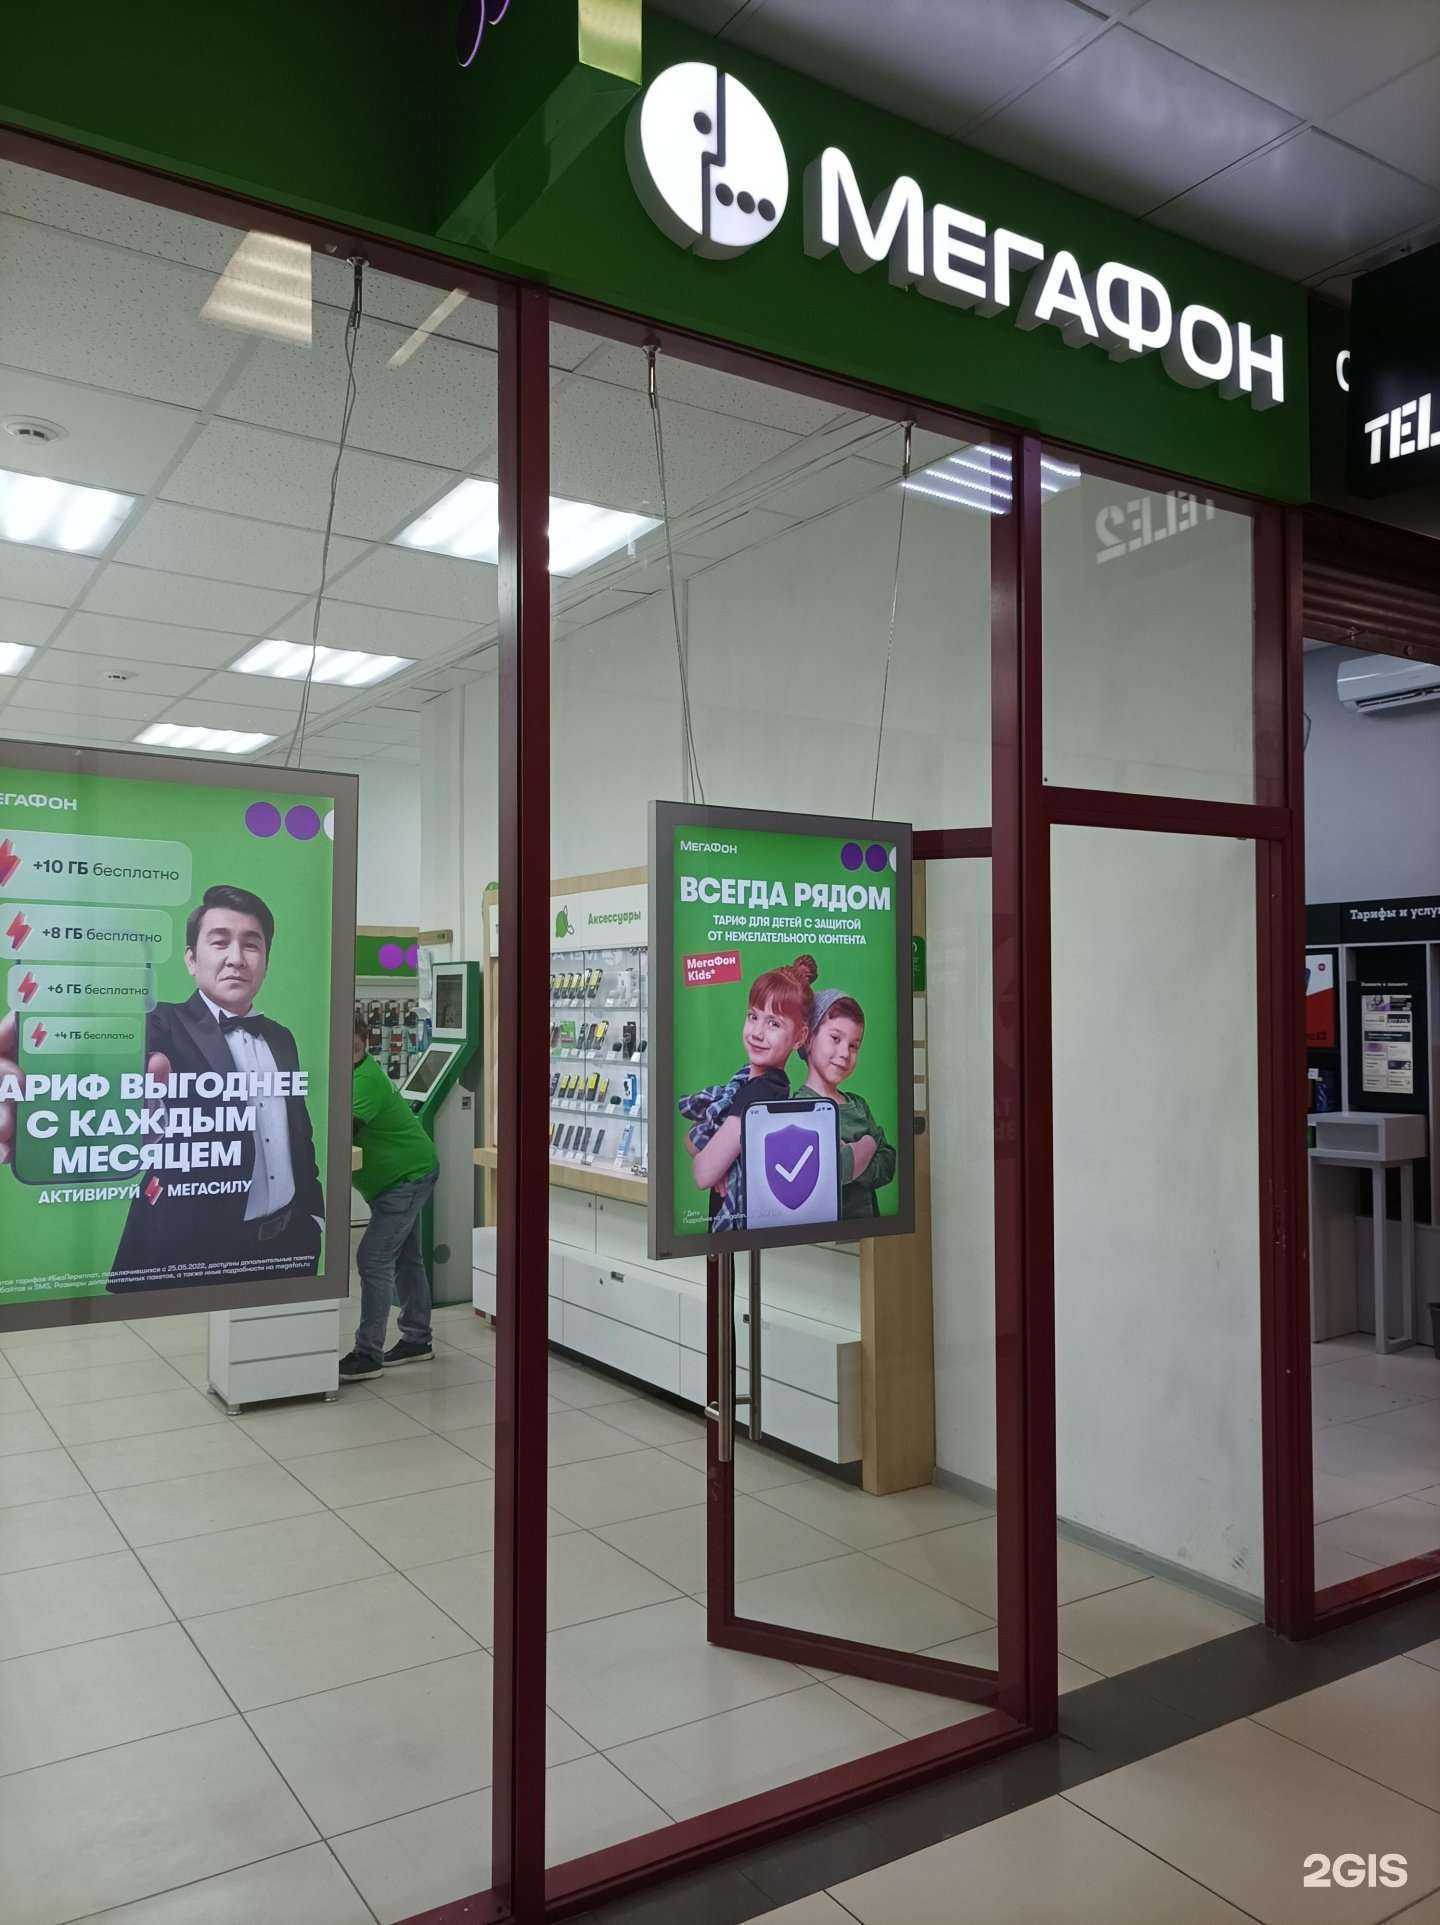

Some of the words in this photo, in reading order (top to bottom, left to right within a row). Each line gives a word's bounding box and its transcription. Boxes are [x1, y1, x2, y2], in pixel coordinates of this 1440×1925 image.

[33, 859, 64, 874] +10
[68, 861, 88, 875] ГБ
[93, 863, 179, 881] бесплатно
[680, 876, 789, 909] ВСЕГДА
[794, 882, 891, 912] РЯДОМ
[588, 911, 641, 925] Аксессуары
[713, 914, 747, 926] ТАРИФ
[749, 916, 769, 928] ДЛЯ
[772, 916, 801, 929] ДЕТЕЙ
[804, 919, 813, 928] С
[815, 918, 861, 930] ЗАЩИТОЙ
[1350, 907, 1396, 922] Тарифы
[42, 927, 61, 939] +8
[65, 928, 83, 940] ГБ
[87, 929, 162, 943] бесплатно
[708, 931, 723, 941] ОТ
[726, 931, 816, 944] НЕЖЕЛАТЕЛЬНОГО
[818, 934, 867, 945] КОНТЕНТА
[48, 984, 63, 995] +6
[67, 985, 82, 994] ГБ
[85, 985, 149, 996] бесплатно
[55, 1032, 67, 1040] +4
[70, 1031, 81, 1039] ГБ
[84, 1031, 134, 1040] бесплатно
[120, 1071, 309, 1101] ВЫГОДНЕЕ
[26, 1110, 59, 1138] С
[69, 1105, 256, 1138] КАЖДЫМ
[53, 1140, 241, 1174] МЕСЯЦЕМ
[38, 1184, 140, 1204] АКТИВИРУЙ
[167, 1180, 252, 1197] МЕГАСИЛУ
